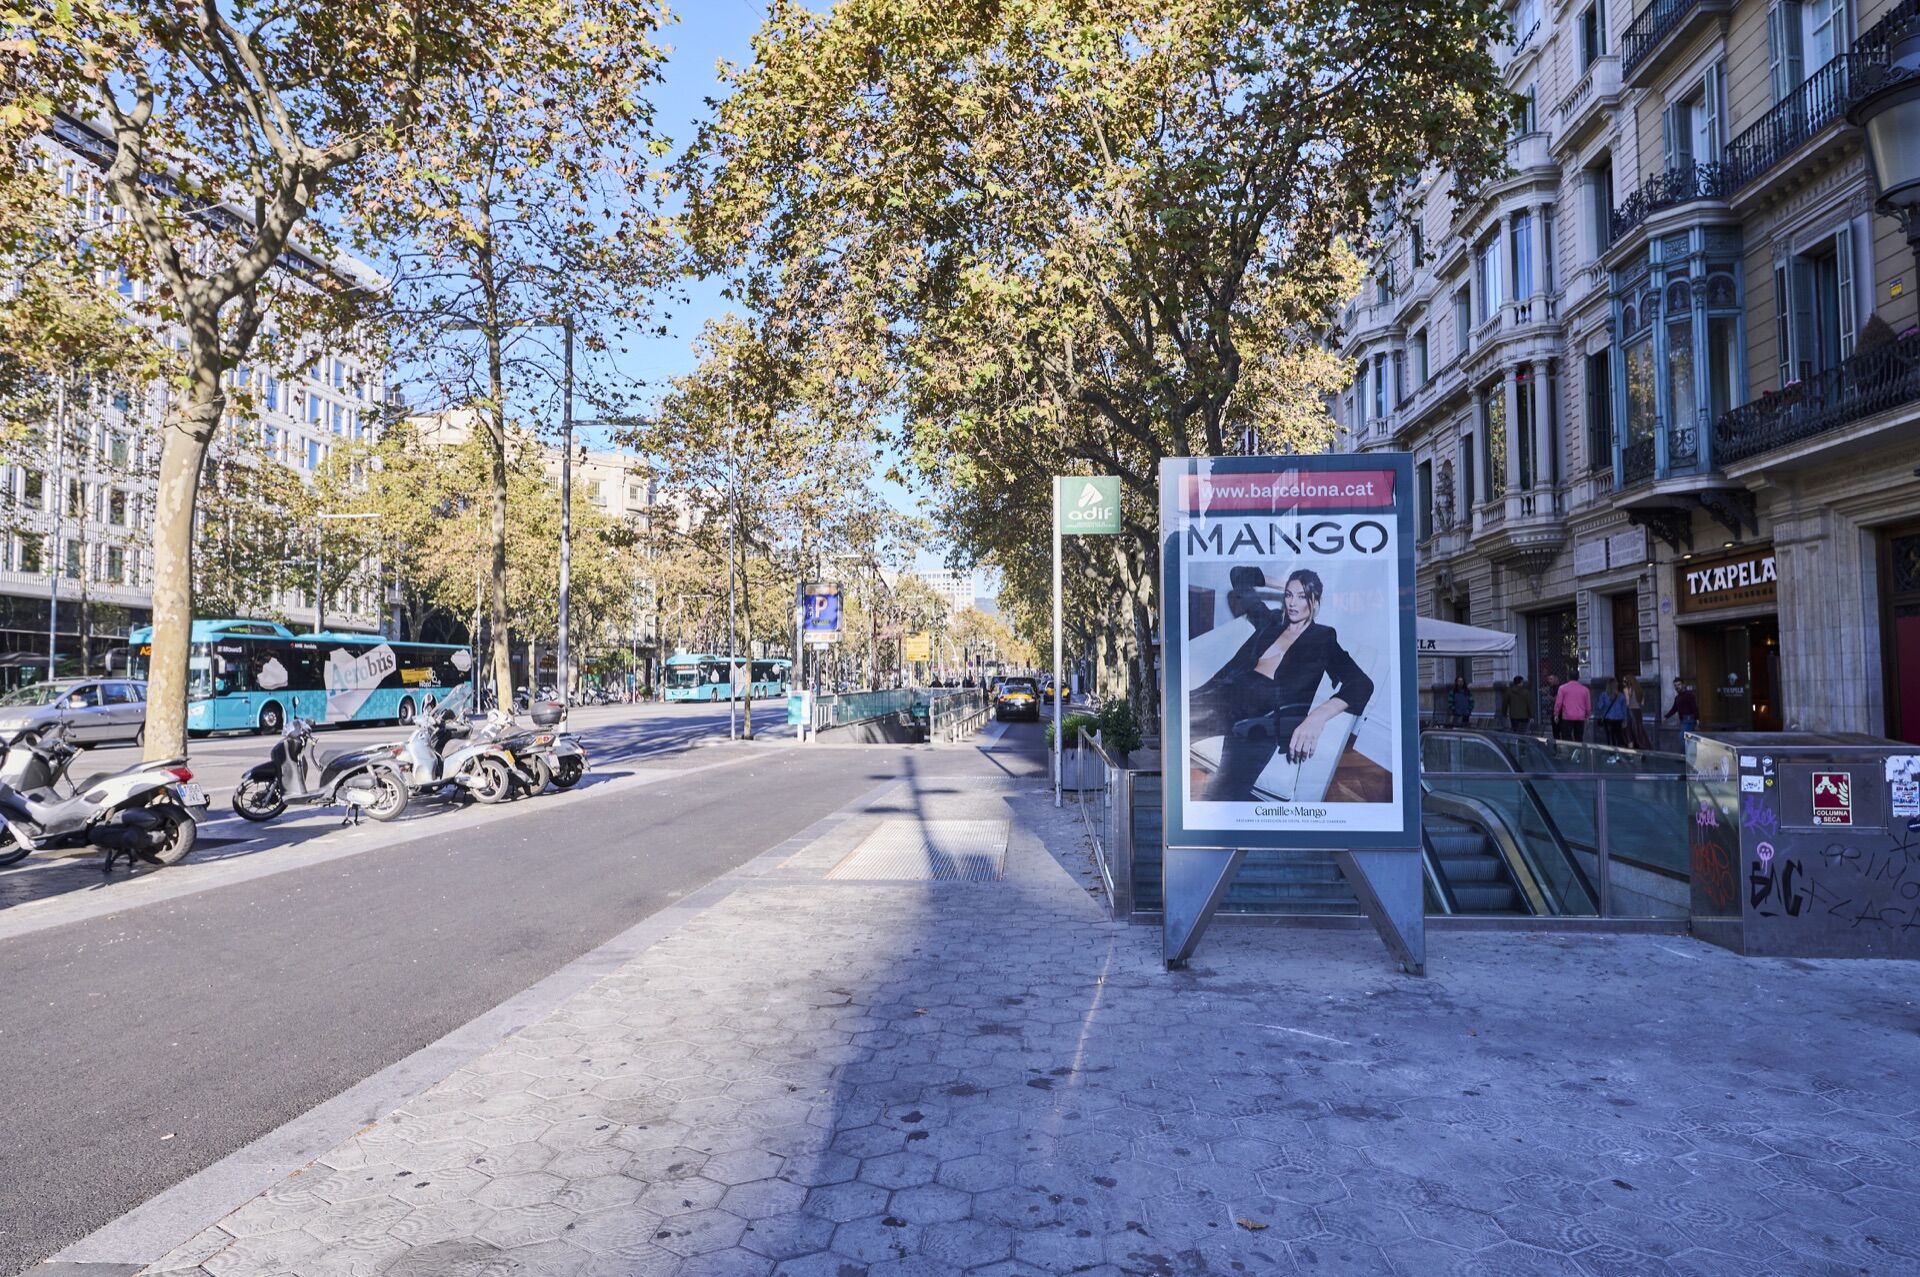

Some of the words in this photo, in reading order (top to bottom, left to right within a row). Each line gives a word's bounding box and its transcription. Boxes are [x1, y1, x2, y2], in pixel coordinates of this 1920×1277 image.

[1201, 481, 1374, 498] www.barcelona.cat
[1068, 506, 1114, 521] adif
[1187, 520, 1389, 556] MANGO
[1686, 556, 1778, 595] TXAPELA
[329, 652, 394, 697] Aerobús
[1816, 809, 1849, 817] COLUMNA
[1823, 816, 1842, 824] SECA
